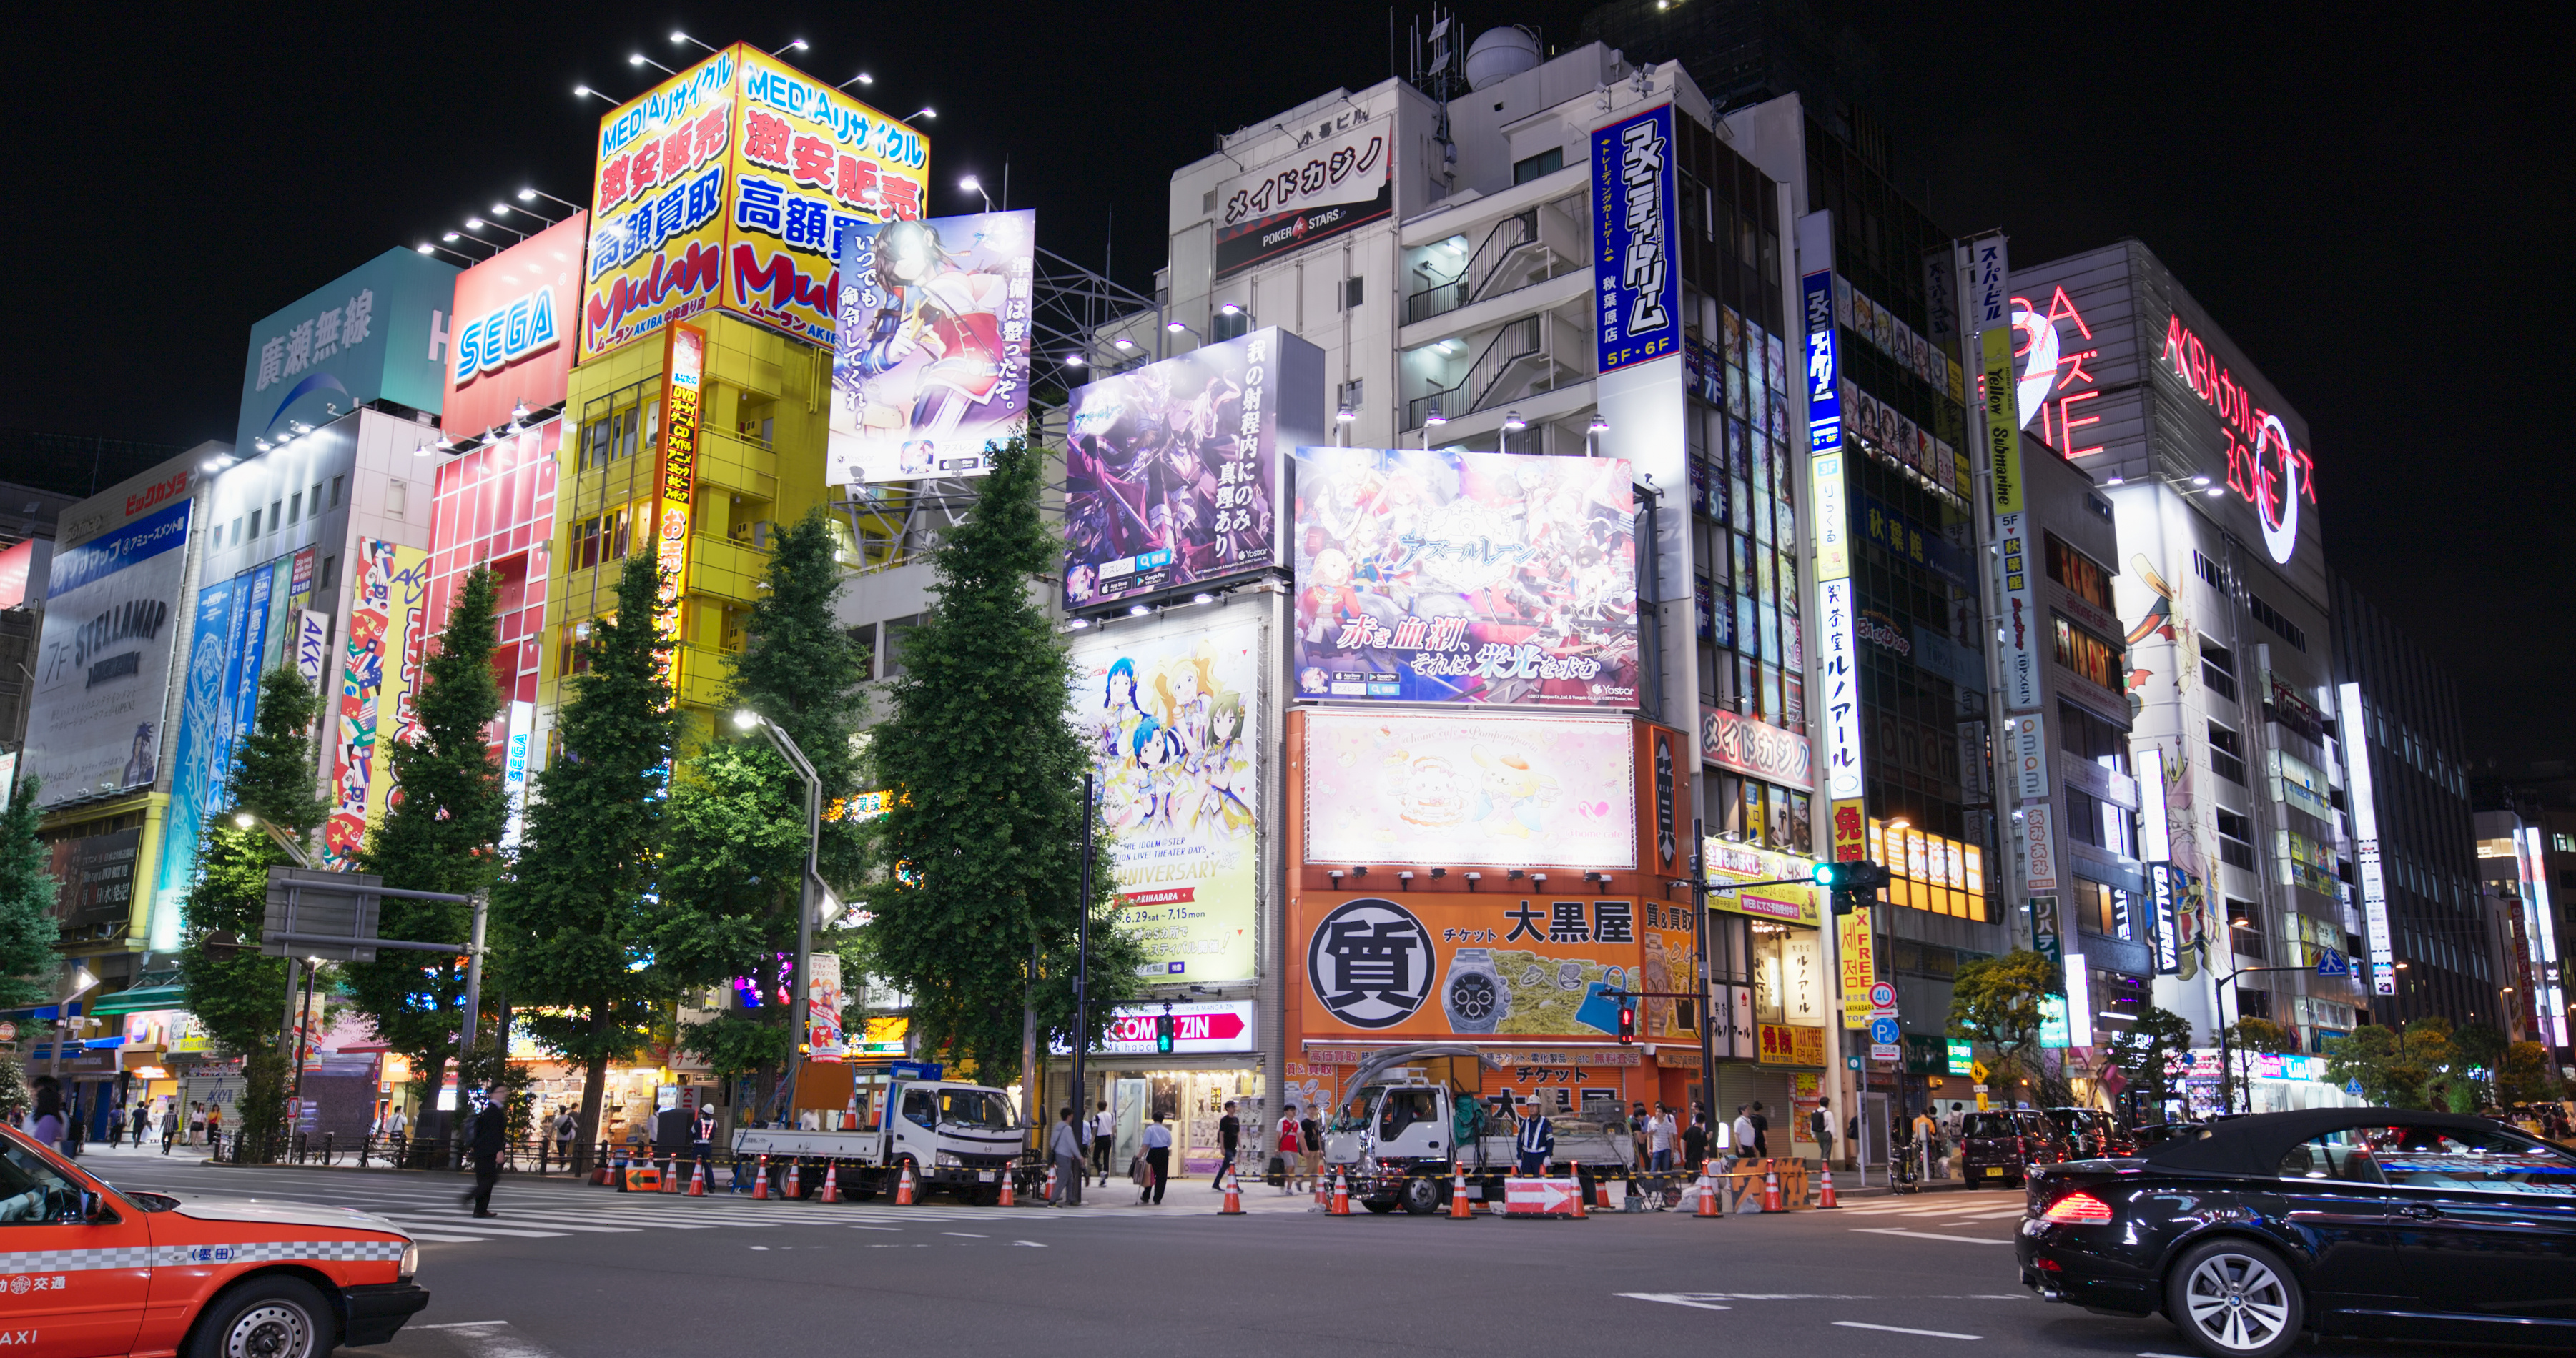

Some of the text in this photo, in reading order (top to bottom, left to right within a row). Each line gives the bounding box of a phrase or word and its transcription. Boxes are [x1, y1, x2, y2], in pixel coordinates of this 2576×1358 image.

[603, 54, 732, 155] MEDIAリサイクル
[748, 69, 923, 166] MEDIAリサイクル
[599, 105, 728, 209] 激安販売
[744, 109, 918, 220] 激安販売
[1225, 137, 1382, 225] メイドカジノ
[1602, 147, 1614, 256] トレーディングカードゲーム
[591, 167, 720, 279] 高額買取
[1263, 227, 1292, 247] POKER
[1623, 120, 1668, 335] アメニティドリーム
[855, 235, 878, 307] いつでも
[1981, 246, 2001, 321] スーパービル
[586, 242, 720, 349] Mulan
[1603, 275, 1619, 343] 秋葉原店
[454, 286, 560, 384] SEGA
[596, 296, 706, 354] ムーラン AKIBA 中央通り店
[749, 300, 806, 331] ムーラン
[995, 256, 1032, 410] 準備は整ったぞ。
[1808, 289, 1835, 402] アメニティドリーム
[673, 387, 696, 402] DVD
[674, 373, 698, 386] あなたの
[1704, 375, 1722, 404] 7F
[1988, 367, 2003, 415] Yellow
[669, 411, 694, 427] ゲーム
[671, 398, 696, 417] ブルーレイ
[668, 435, 693, 453] アイドル
[673, 425, 689, 438] CD
[1215, 338, 1266, 558] 我の射程内にのみ 真理あり
[666, 462, 691, 477] コミック
[668, 449, 691, 465] アニメ
[1819, 461, 1837, 474] 3F
[1992, 427, 2010, 506] Submarine
[125, 470, 187, 517] ビックカメラ
[665, 487, 688, 503] フィギュア
[666, 475, 689, 489] ホビー
[2221, 427, 2283, 532] ZONE
[1824, 485, 1837, 543] りらくる
[2003, 515, 2018, 527] 5F
[1245, 548, 1268, 558] Yostar
[1869, 507, 1923, 563] 秋葉館
[1101, 562, 1130, 575] アズレン
[2004, 539, 2023, 590] 秋葉館
[75, 599, 167, 666] STELLAMAP
[1336, 614, 1471, 653] 赤き血潮、
[1715, 612, 1732, 642] 5F
[45, 641, 69, 685] 7F
[1410, 644, 1601, 680] それは栄光を求む
[1602, 684, 1634, 695] Yostar
[508, 733, 528, 782] SEGA
[1703, 714, 1809, 780] メイドカジノ
[2021, 719, 2041, 794] amiami
[1134, 846, 1207, 861] LIVE! THEATER DAYS
[1138, 837, 1186, 849] IDOLM@STER
[1707, 845, 1760, 874] 全身もみほぐし
[2028, 809, 2048, 876] あみあみ
[1137, 892, 1178, 904] AKIHABARA
[1742, 898, 1756, 909] WEB
[1443, 926, 1497, 944] チケット
[1504, 900, 1634, 944] 大黒屋
[2153, 866, 2176, 971] GALLERIA
[1321, 918, 1423, 1013] 質
[1858, 933, 1872, 988] FREE
[1796, 955, 1810, 1013] ルノアール
[1875, 989, 1890, 1001] 40
[1180, 1016, 1210, 1039] ZIN
[1762, 1025, 1794, 1056] 免税
[1795, 1028, 1822, 1049] TAX FREE
[1877, 1024, 1888, 1041] P
[1309, 1049, 1639, 1066] 高価買取 無料査定
[1516, 1065, 1589, 1084] チケット
[1797, 1048, 1823, 1066] 면세점
[33, 1276, 66, 1291] 交通
